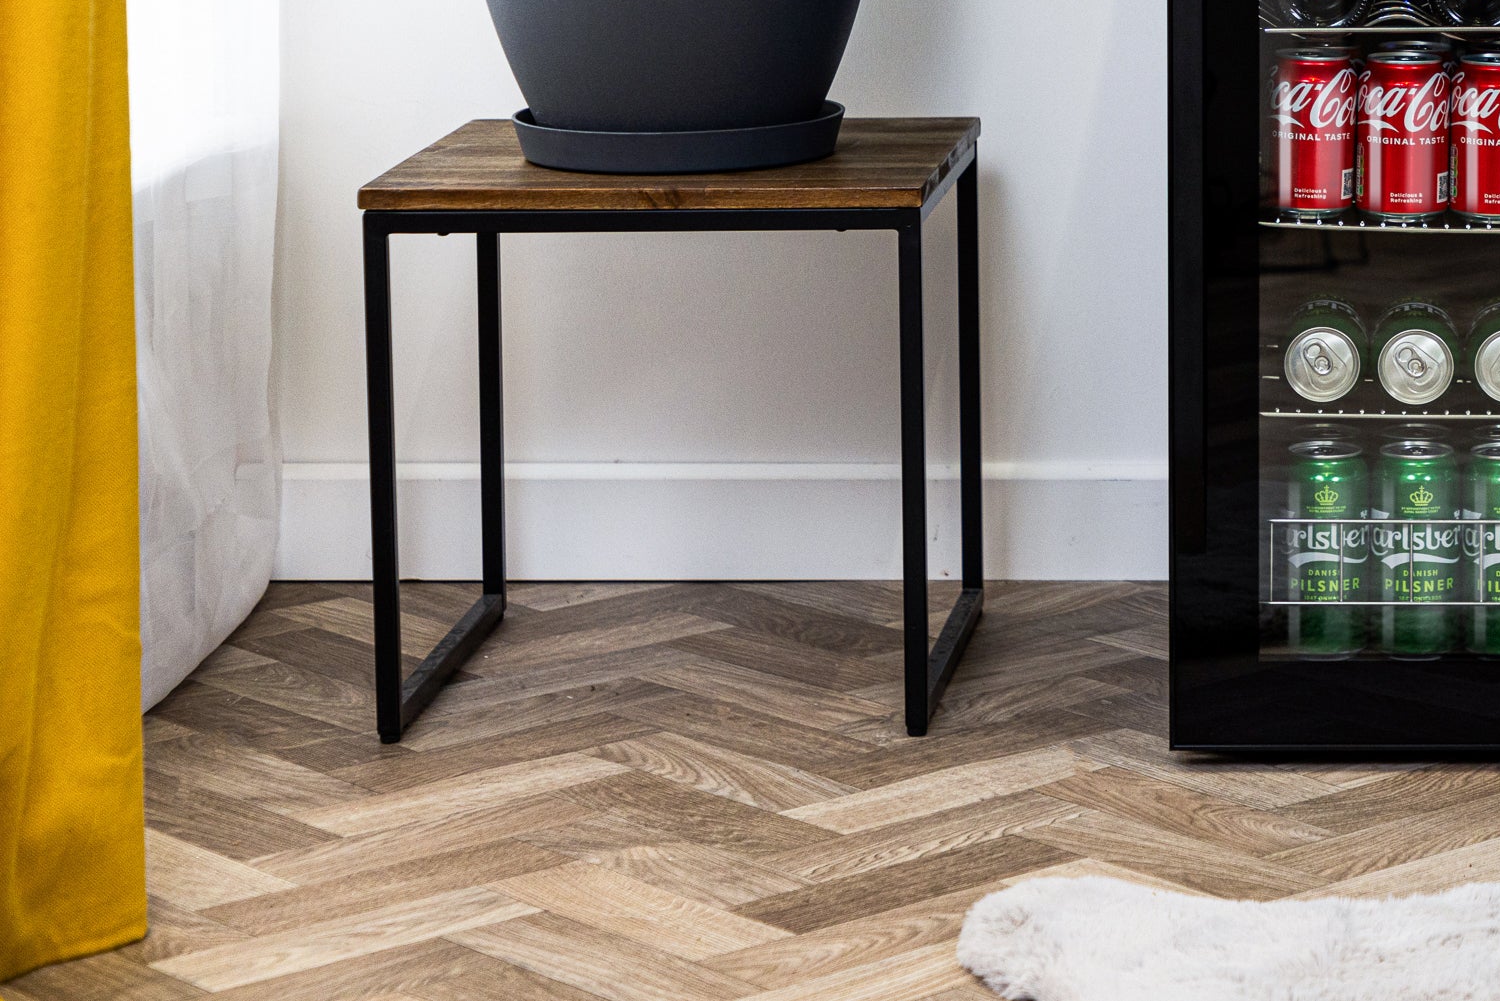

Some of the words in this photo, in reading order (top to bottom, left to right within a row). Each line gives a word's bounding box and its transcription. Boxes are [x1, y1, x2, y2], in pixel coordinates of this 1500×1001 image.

[1272, 130, 1320, 141] ORIGINAL
[1325, 133, 1350, 141] TASTE
[1367, 135, 1415, 145] ORIGINAL
[1420, 136, 1445, 145] TASTE
[1308, 569, 1340, 577] DANIS
[1290, 578, 1360, 592] PILSNER
[1385, 577, 1454, 593] PILSNER
